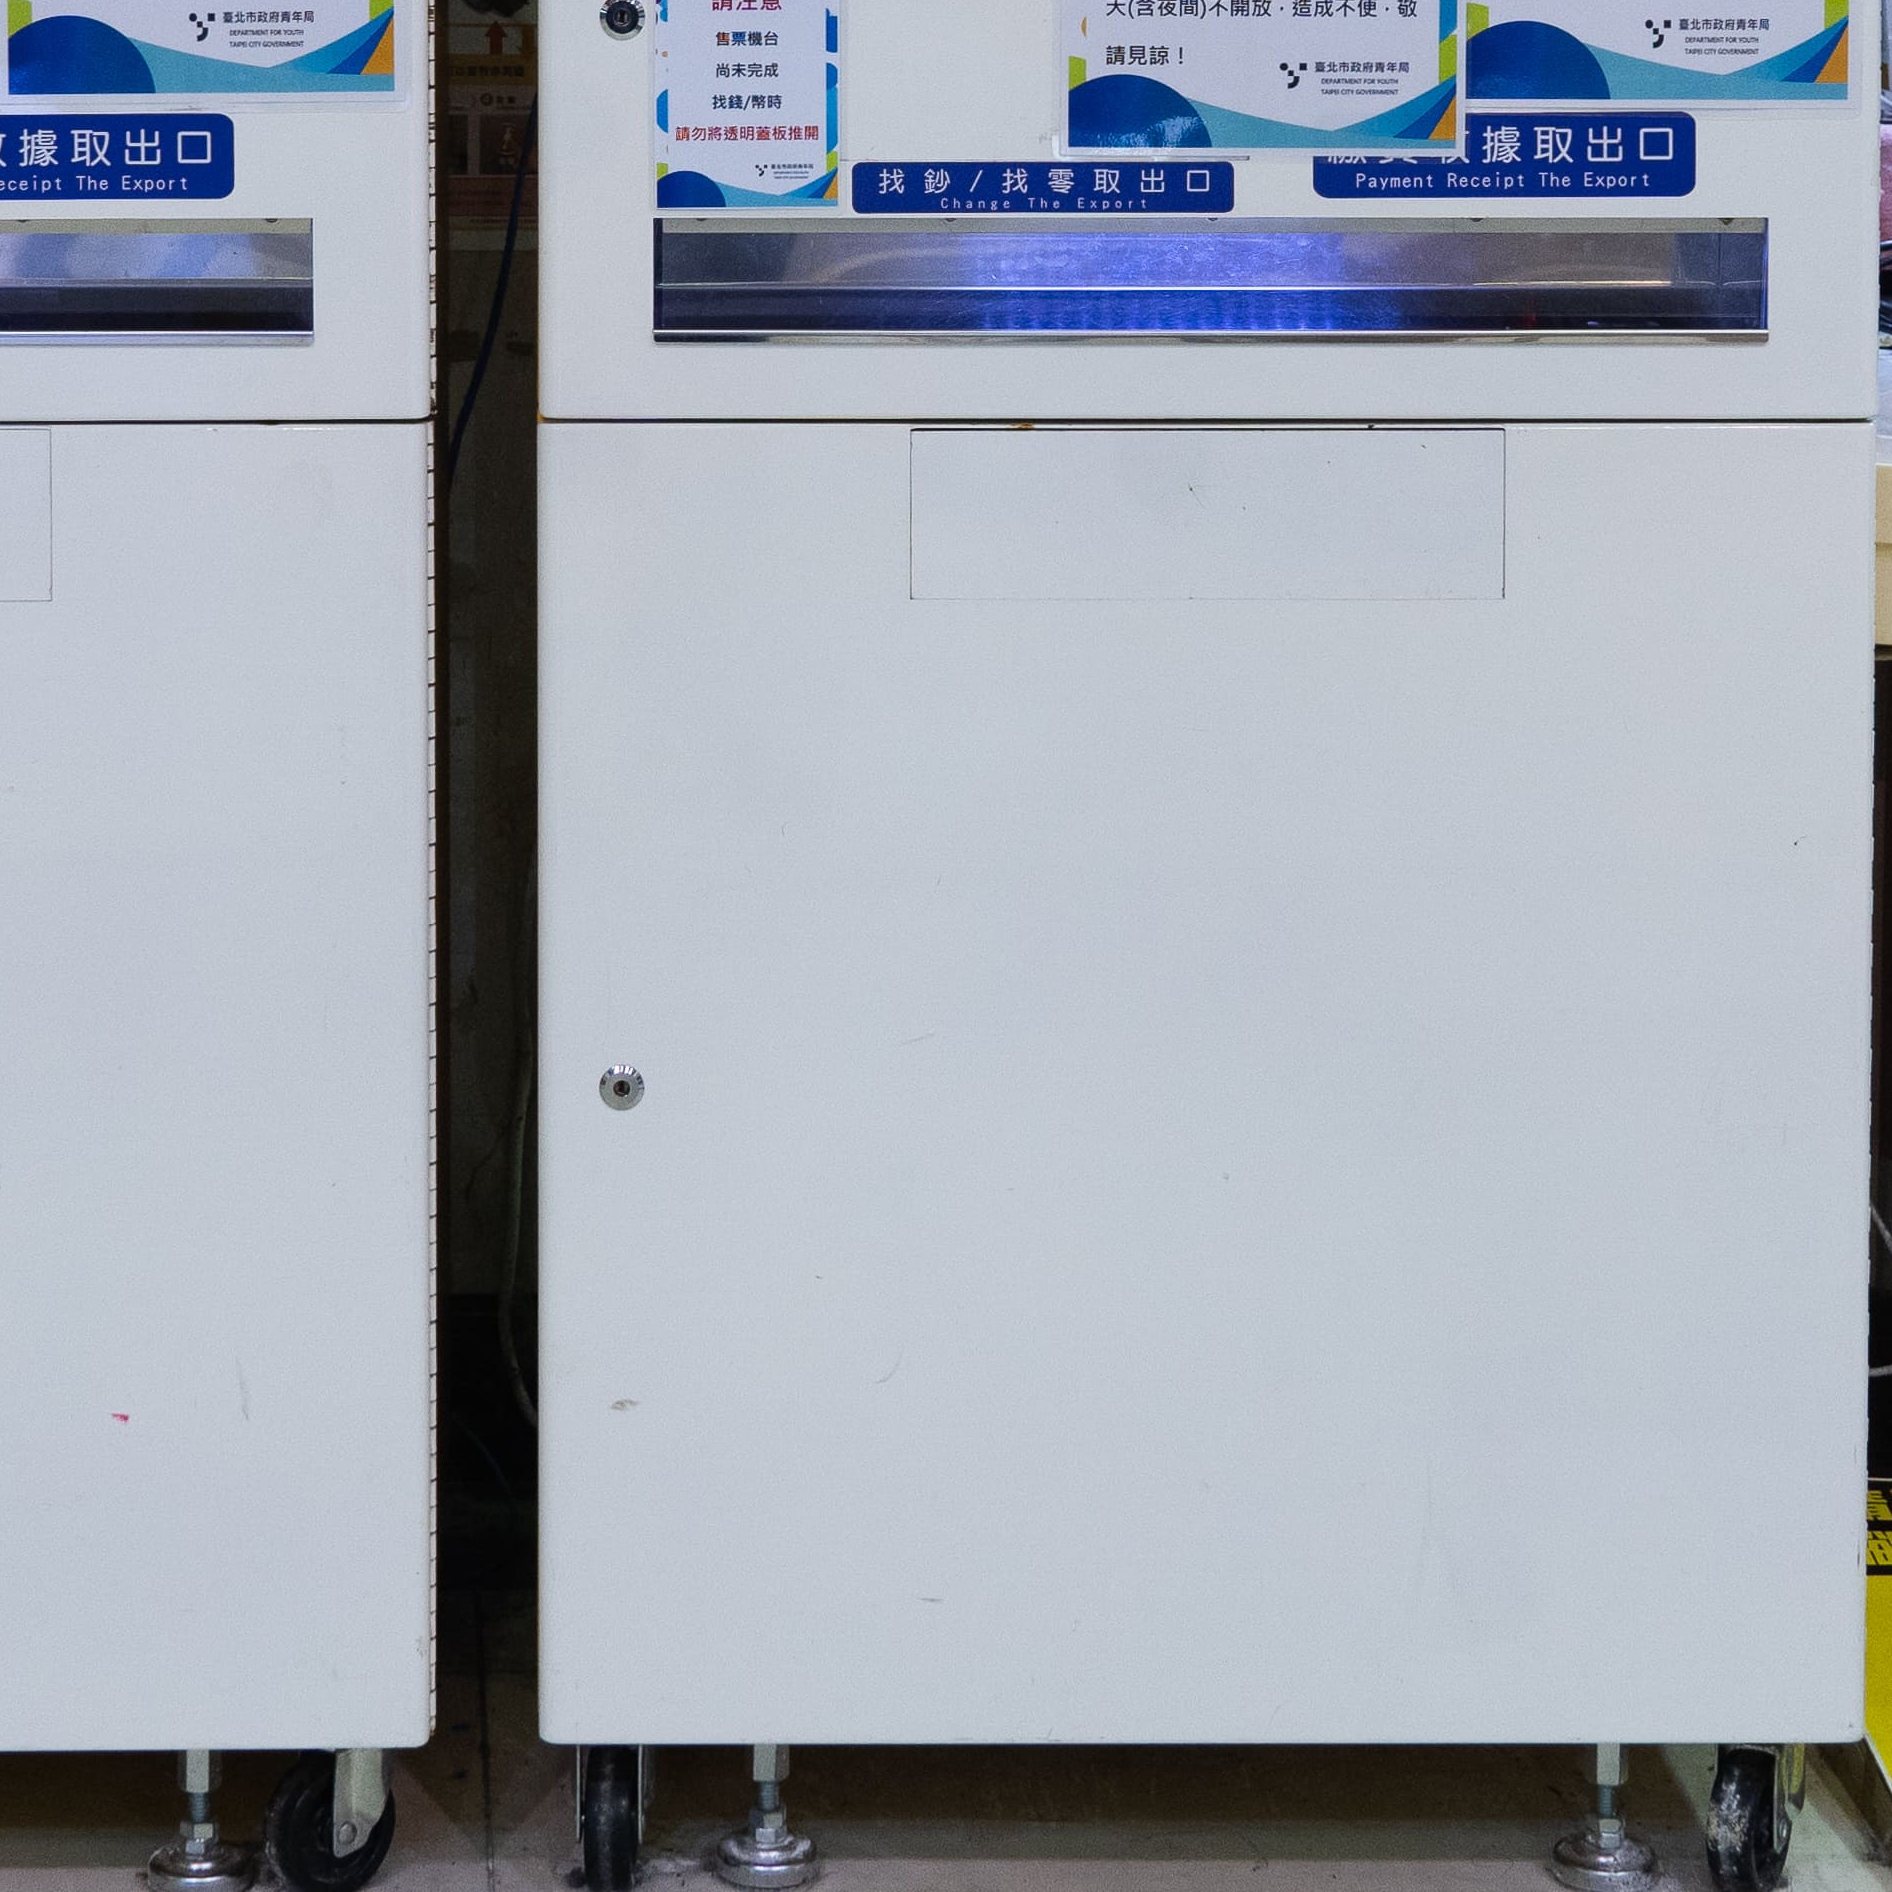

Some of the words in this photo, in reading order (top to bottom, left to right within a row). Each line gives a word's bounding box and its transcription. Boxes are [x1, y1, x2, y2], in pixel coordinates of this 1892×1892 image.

[716, 31, 779, 46] 售票機台
[1106, 46, 1183, 65] 請見諒！
[716, 63, 779, 78] 尚未完成
[1327, 126, 1673, 164] 據取出口
[76, 176, 109, 190] The
[122, 175, 188, 191] Export
[1356, 173, 1434, 190] Payment
[1447, 173, 1525, 190] Receipt
[1539, 172, 1571, 188] The
[1584, 172, 1650, 189] Export
[941, 198, 1011, 210] Change
[1028, 198, 1061, 210] The
[1078, 198, 1148, 210] Export
